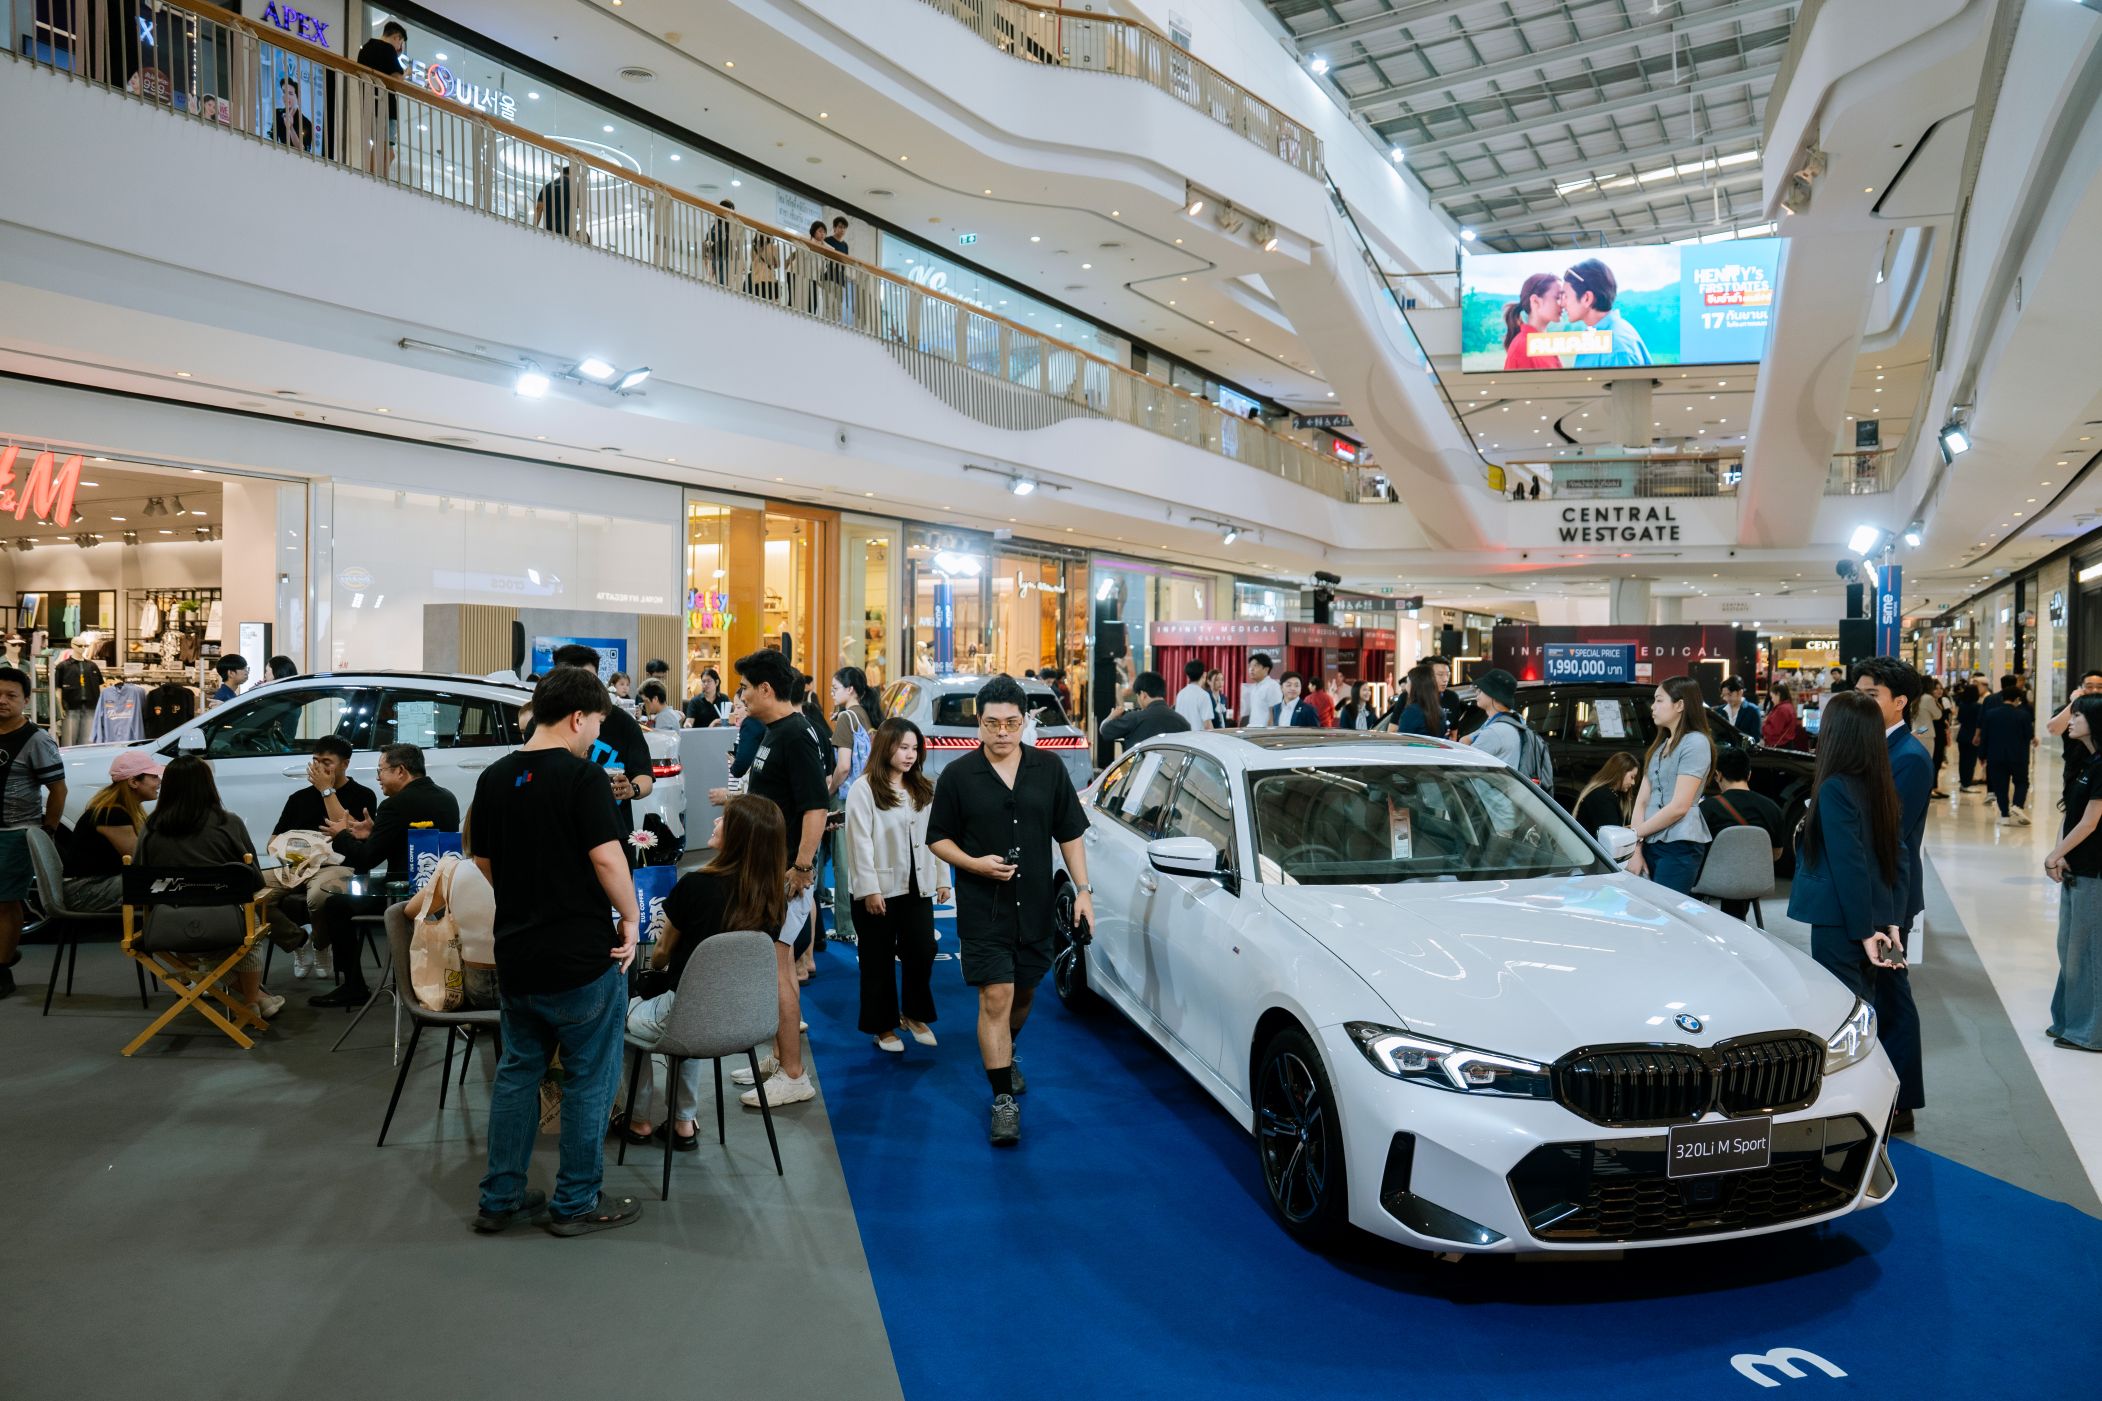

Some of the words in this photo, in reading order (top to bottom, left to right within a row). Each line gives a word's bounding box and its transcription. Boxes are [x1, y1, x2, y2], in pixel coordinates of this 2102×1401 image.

[260, 0, 330, 48] APEX
[483, 88, 517, 122] 서울
[1701, 311, 1725, 329] 17
[1562, 506, 1676, 523] CENTRAL
[1559, 525, 1680, 542] WESTGATE
[687, 591, 728, 612] Jelly
[1156, 625, 1213, 633] INFINITY
[1220, 625, 1277, 633] MEDICAL
[1575, 648, 1601, 657] SPECIAL
[1601, 649, 1621, 657] PRICE
[1641, 646, 1721, 657] EDICAL
[1548, 659, 1605, 678] 1,990,000
[1607, 665, 1623, 675] บาท
[1675, 1142, 1715, 1159] 320Li
[1718, 1141, 1730, 1154] M
[1733, 1137, 1767, 1155] Sport
